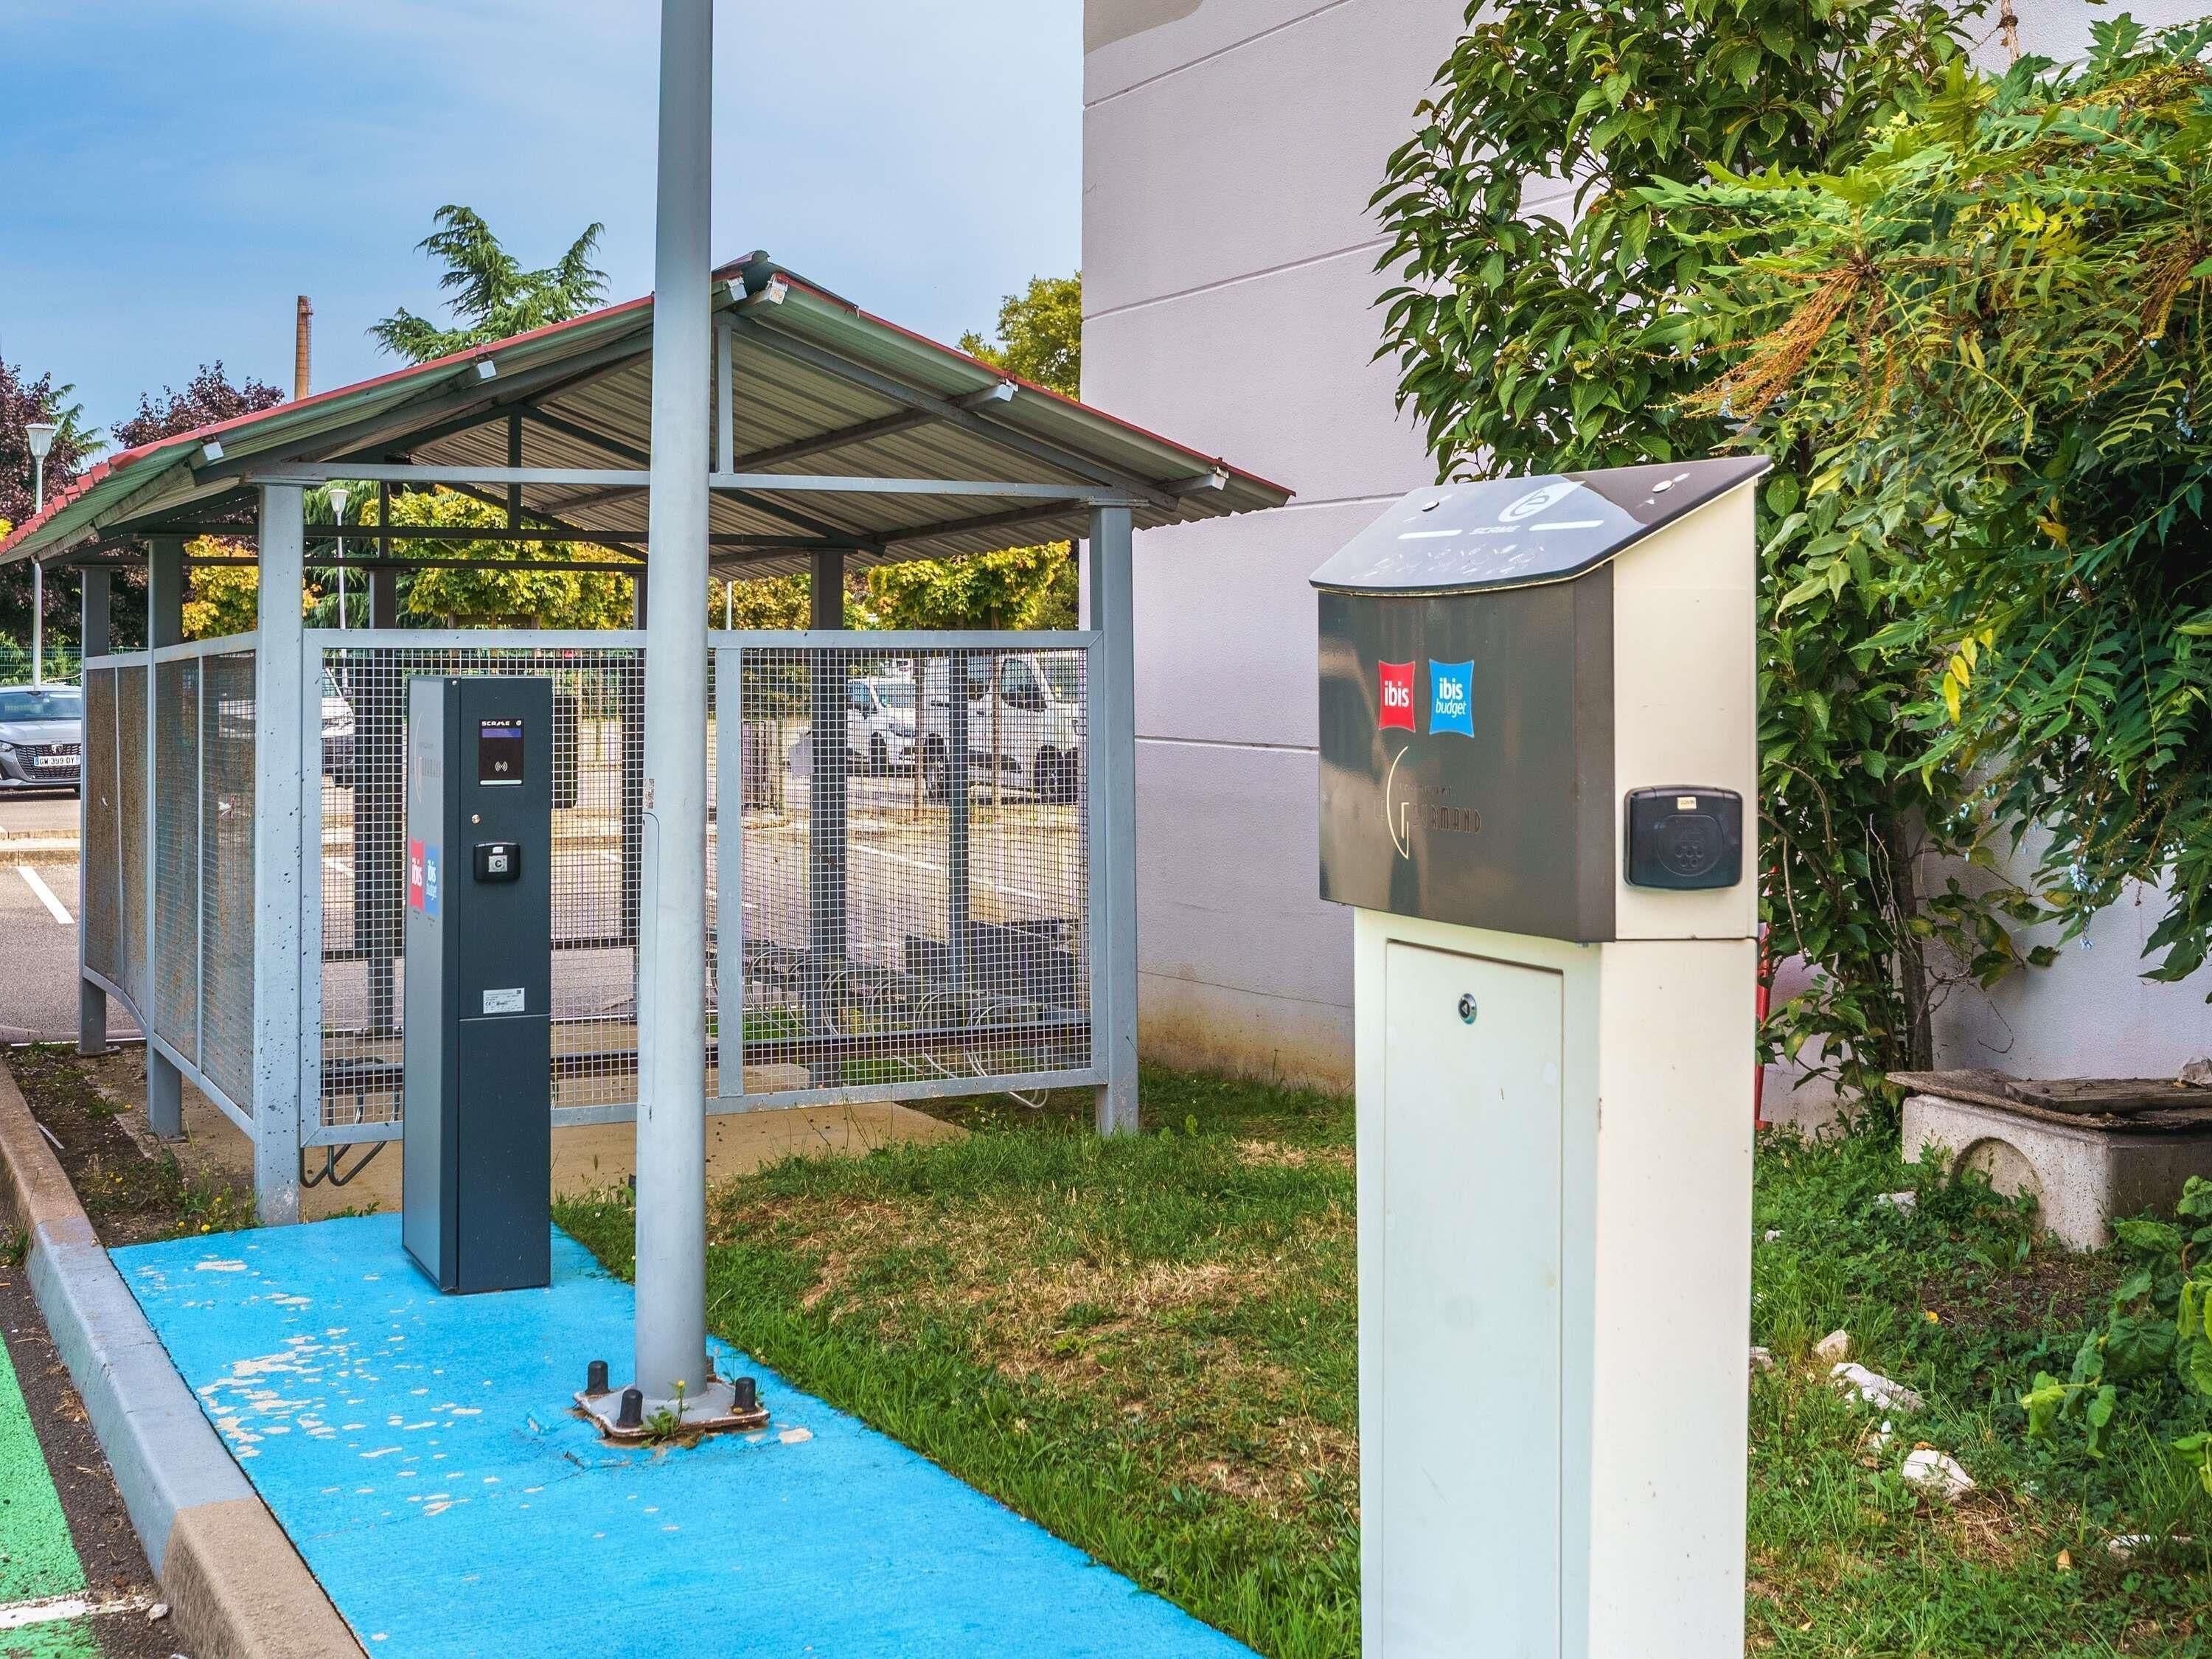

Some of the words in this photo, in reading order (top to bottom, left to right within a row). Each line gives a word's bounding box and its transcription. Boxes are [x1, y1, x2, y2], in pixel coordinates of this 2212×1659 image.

[1385, 681, 1410, 708] ibis
[1439, 677, 1464, 700] ibis
[1436, 698, 1467, 718] budget
